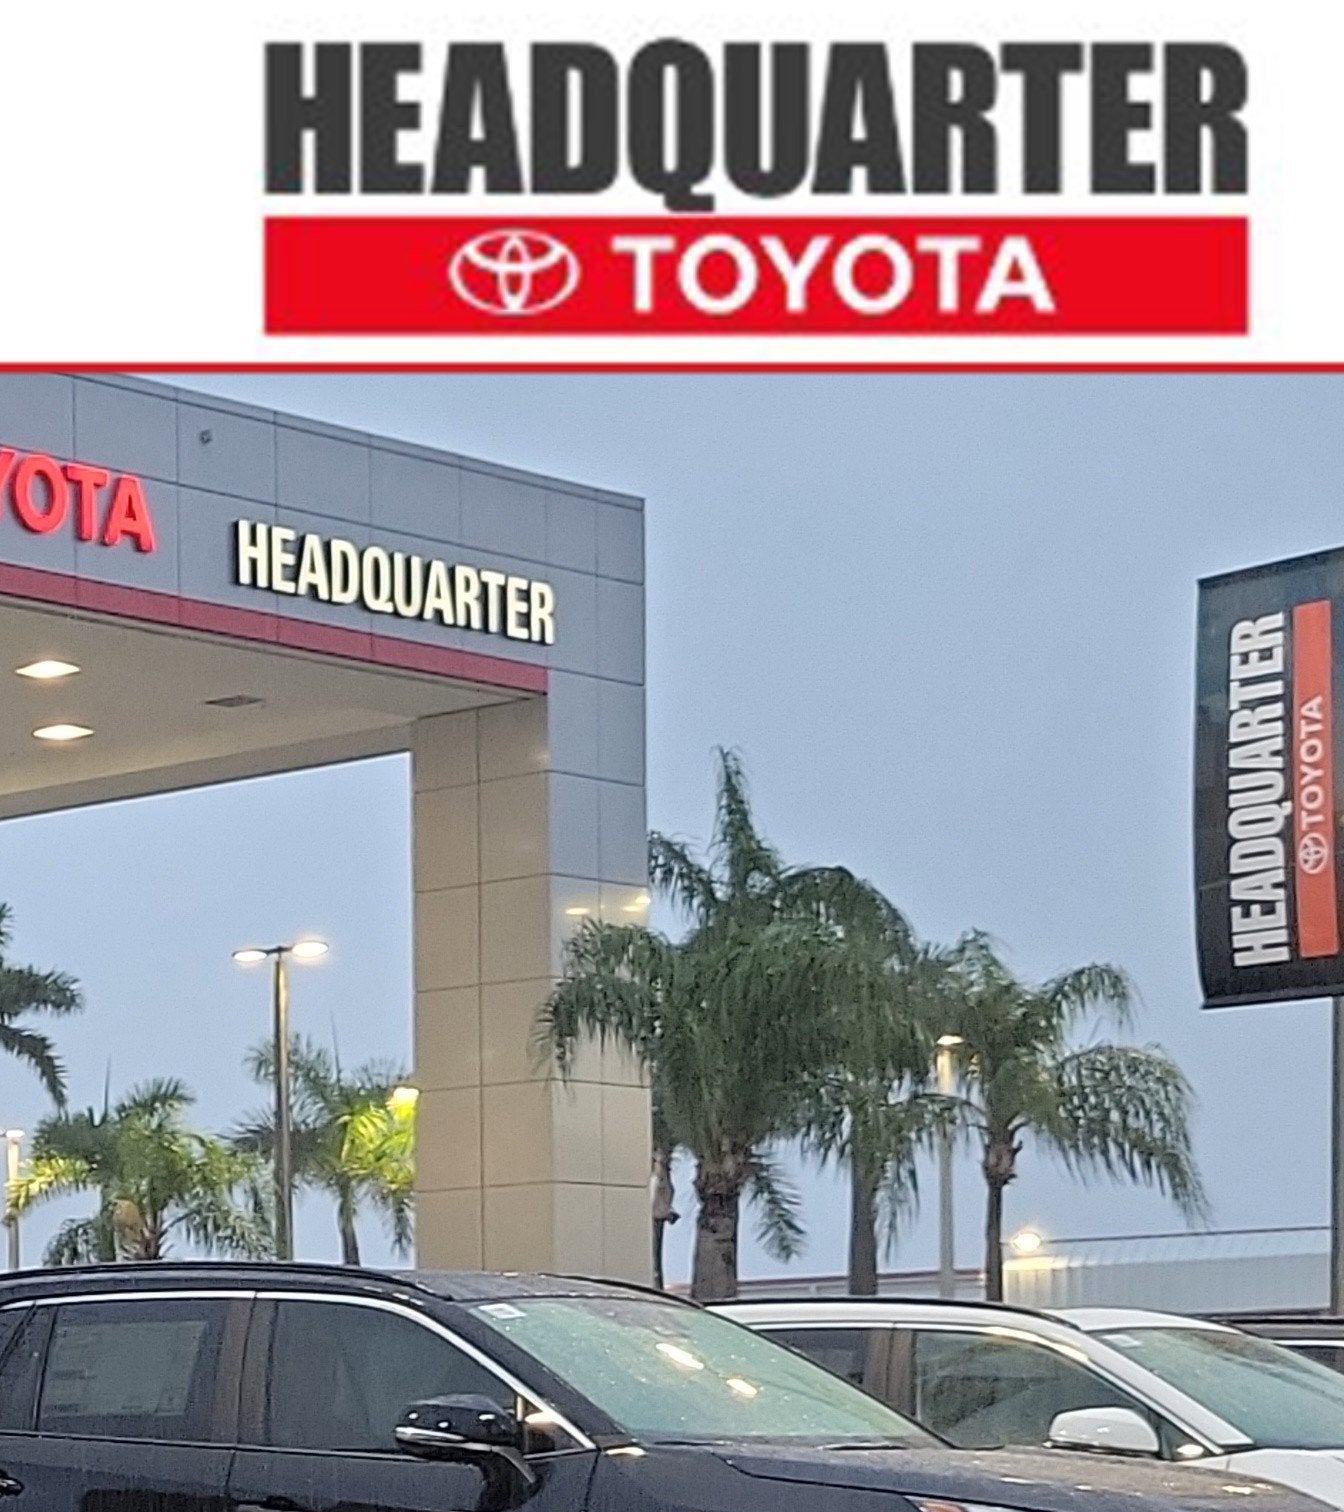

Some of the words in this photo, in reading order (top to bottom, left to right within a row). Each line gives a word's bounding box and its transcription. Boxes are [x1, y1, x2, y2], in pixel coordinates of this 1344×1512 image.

[236, 518, 556, 645] HEADQUARTER
[1228, 611, 1293, 967] HEADQUARTER
[1299, 696, 1326, 830] TOYOTA
